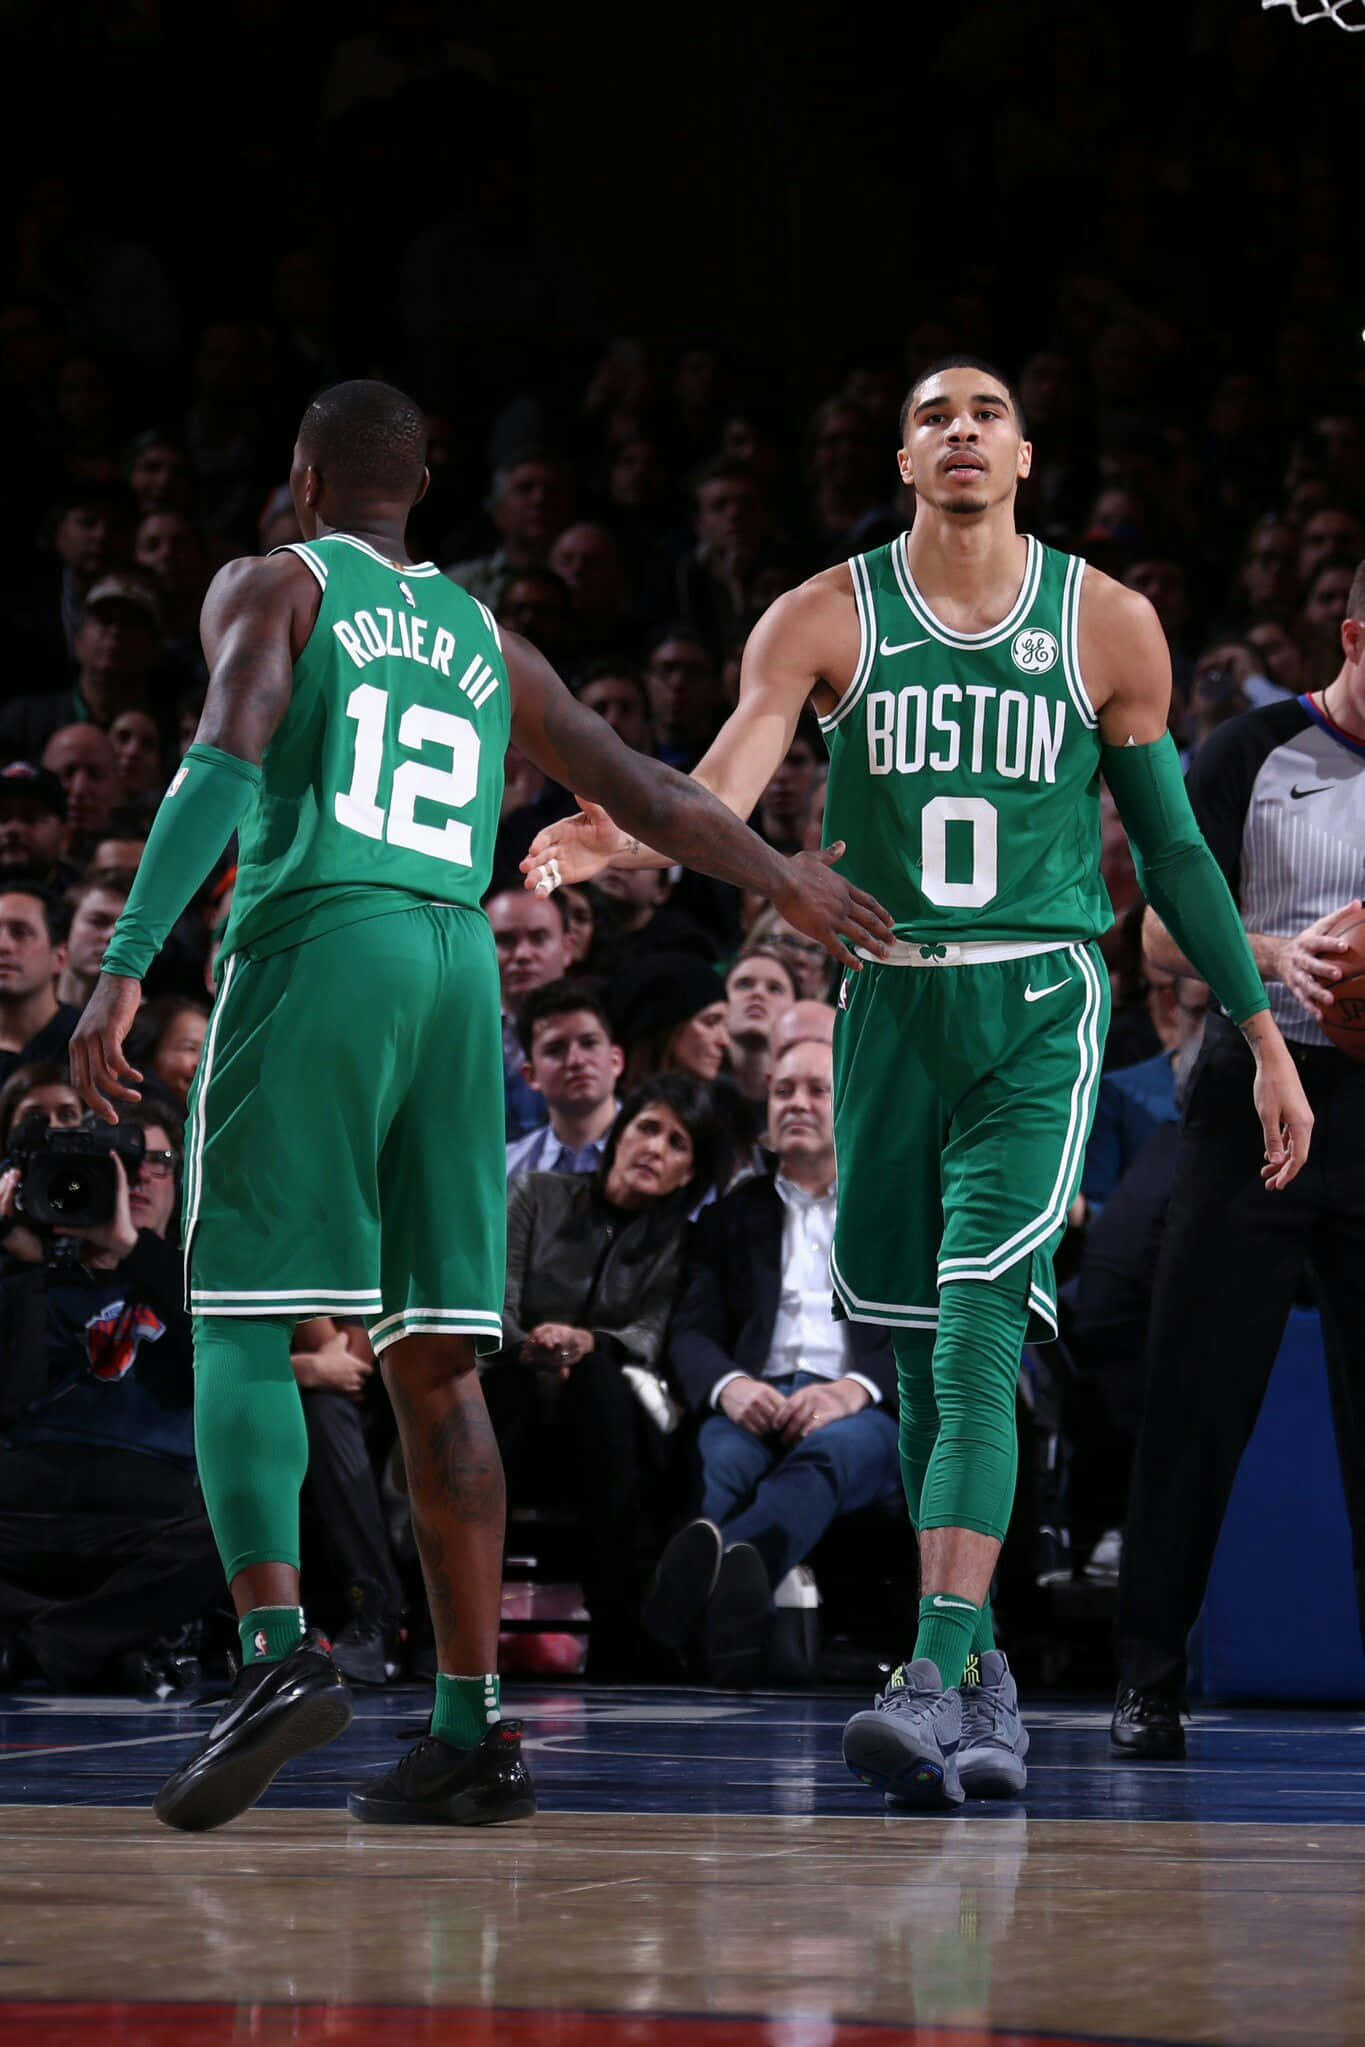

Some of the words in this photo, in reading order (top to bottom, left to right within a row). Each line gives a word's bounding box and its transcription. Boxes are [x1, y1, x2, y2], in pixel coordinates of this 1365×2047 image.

[332, 607, 456, 677] ROZIER
[458, 653, 500, 710] III
[1021, 637, 1050, 664] GE
[334, 682, 481, 868] 12
[866, 684, 1066, 784] BOSTON
[921, 796, 998, 909] 0
